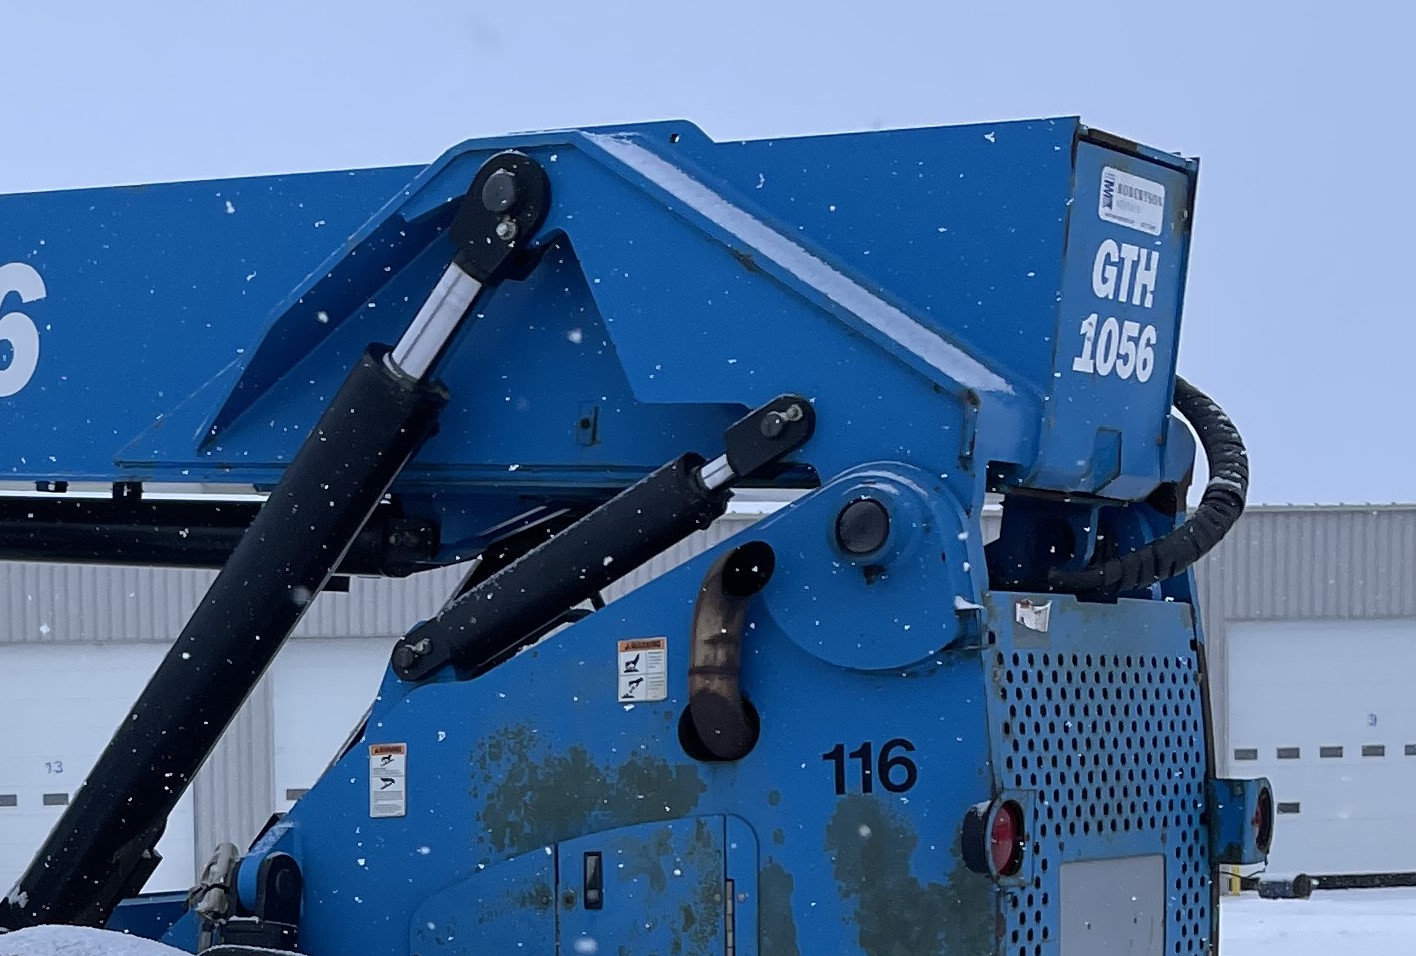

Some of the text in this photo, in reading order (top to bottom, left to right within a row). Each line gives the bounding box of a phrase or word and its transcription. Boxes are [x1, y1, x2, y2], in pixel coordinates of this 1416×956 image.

[1092, 239, 1159, 308] GTH
[1072, 313, 1157, 383] 1056
[45, 761, 64, 775] 13
[822, 738, 917, 796] 116
